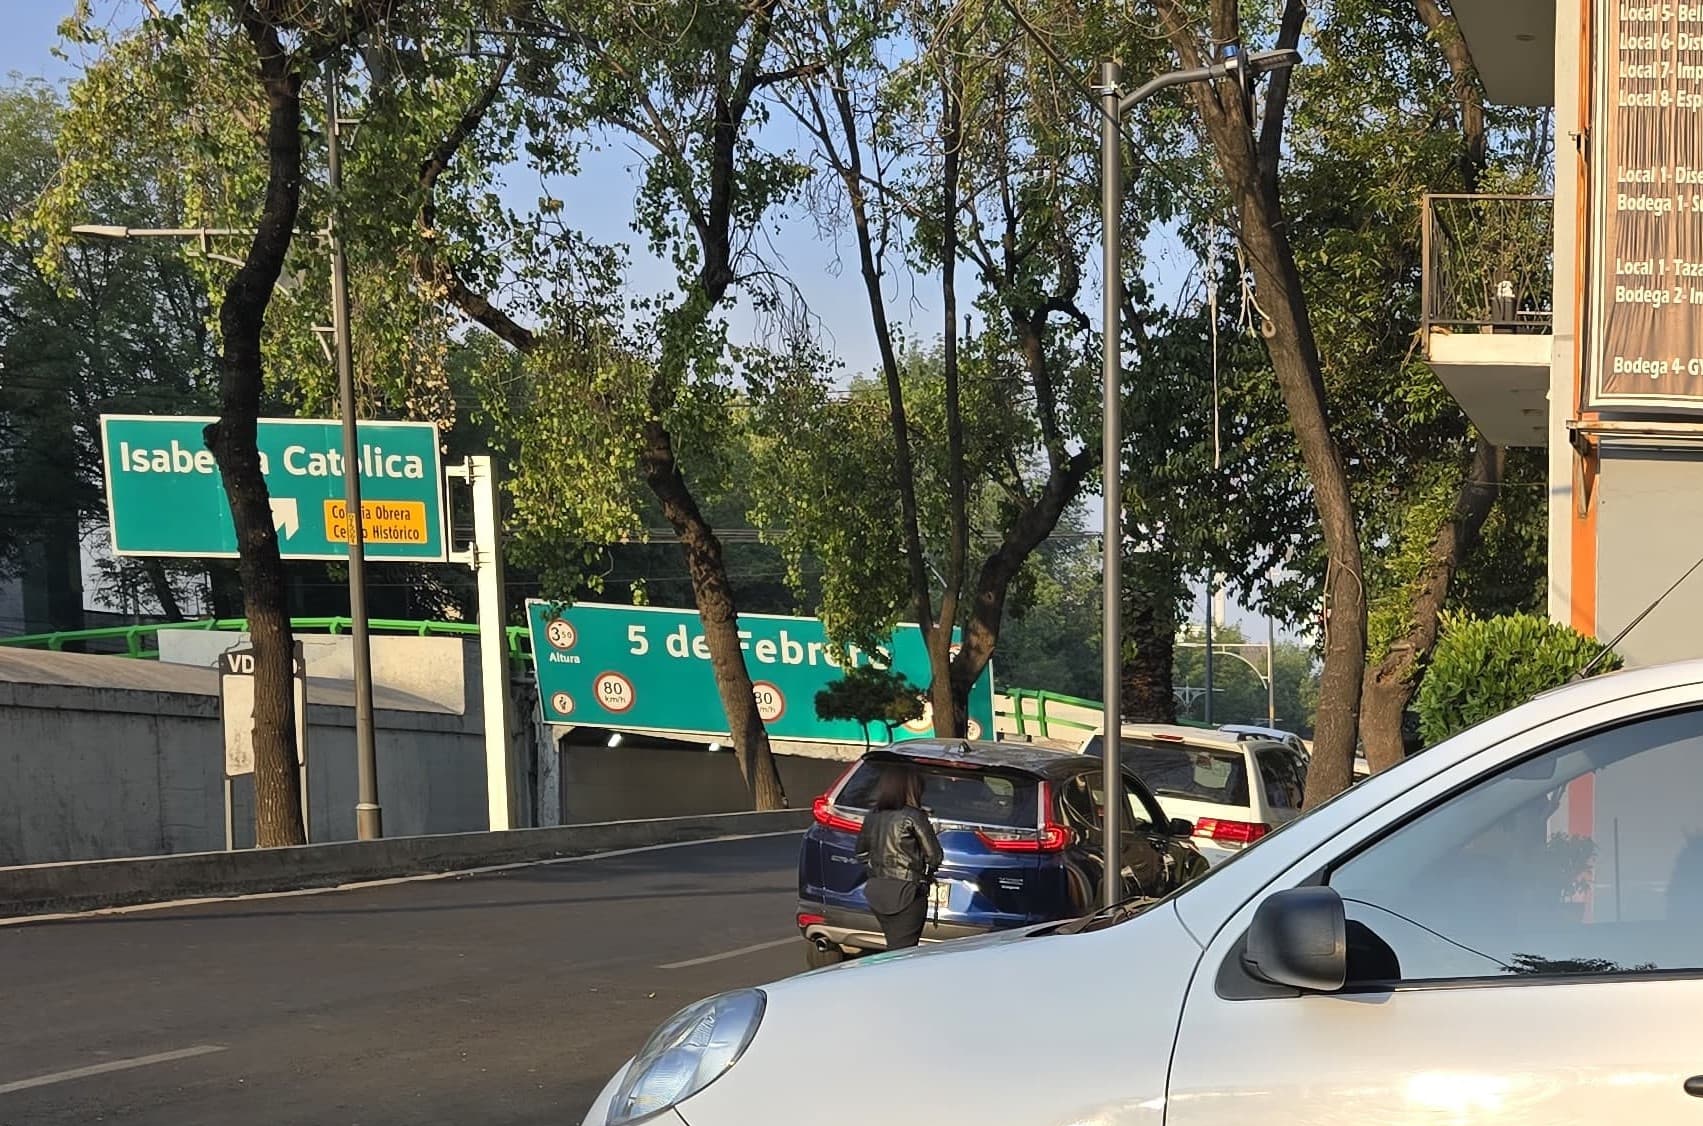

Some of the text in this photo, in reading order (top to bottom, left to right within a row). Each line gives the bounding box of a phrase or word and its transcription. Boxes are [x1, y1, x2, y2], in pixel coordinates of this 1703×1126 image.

[1619, 4, 1658, 22] Local
[1661, 5, 1675, 22] 5-
[1619, 33, 1658, 50] Local
[1660, 34, 1675, 50] 6-
[1619, 61, 1657, 79] Local
[1660, 62, 1674, 79] 7-
[1618, 90, 1657, 108] Local
[1659, 90, 1673, 108] 8-
[1617, 166, 1656, 183] Local
[1660, 166, 1673, 184] 1-
[1617, 194, 1673, 217] Bodega
[1677, 195, 1690, 213] 1-
[1616, 258, 1654, 276] Local
[1658, 259, 1671, 276] 1-
[1615, 286, 1671, 309] Bodega
[1673, 287, 1688, 304] 2-
[1613, 356, 1668, 379] Bodega
[1671, 358, 1686, 374] 4-
[120, 440, 270, 475] Isabea
[375, 505, 411, 521] Obrera
[372, 524, 420, 540] Histórico
[627, 624, 649, 656] 5
[666, 624, 712, 660] de
[549, 651, 581, 664] Altura
[603, 681, 623, 695] 80
[604, 694, 627, 705] km/h
